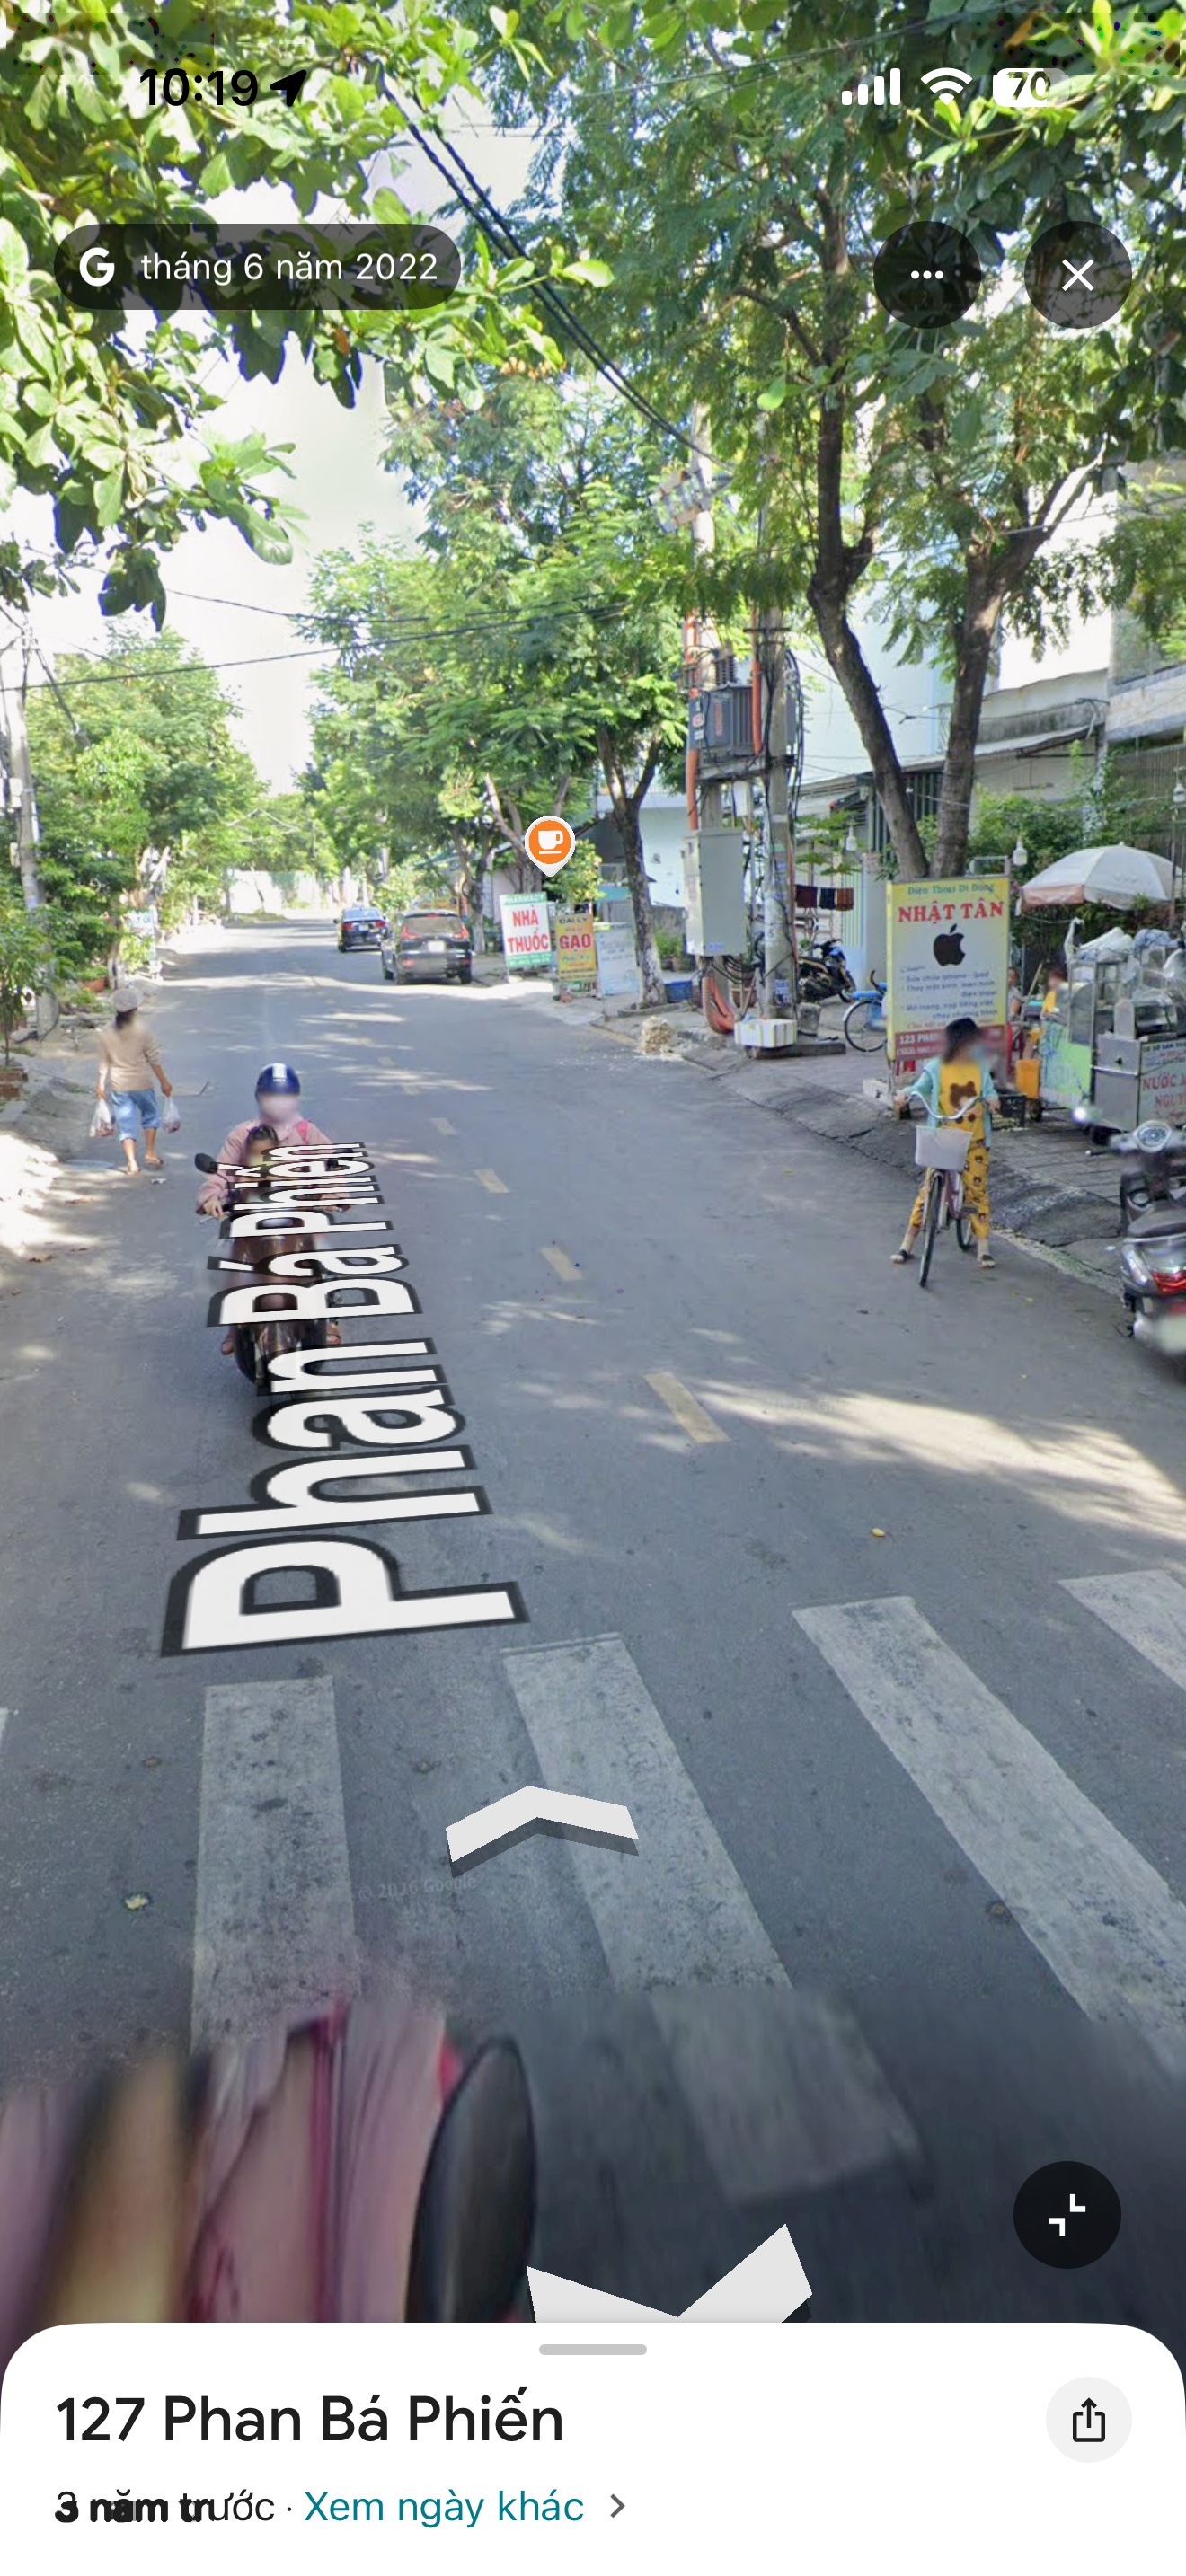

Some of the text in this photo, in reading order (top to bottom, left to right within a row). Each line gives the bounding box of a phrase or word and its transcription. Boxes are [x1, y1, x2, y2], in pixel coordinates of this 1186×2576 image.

[512, 904, 539, 927] NHÀ
[898, 897, 1004, 923] NHẬT TÂN
[508, 928, 549, 953] THUỐC
[560, 933, 592, 952] GẠO
[900, 1035, 915, 1045] 123
[1142, 1072, 1176, 1090] NƯỚC
